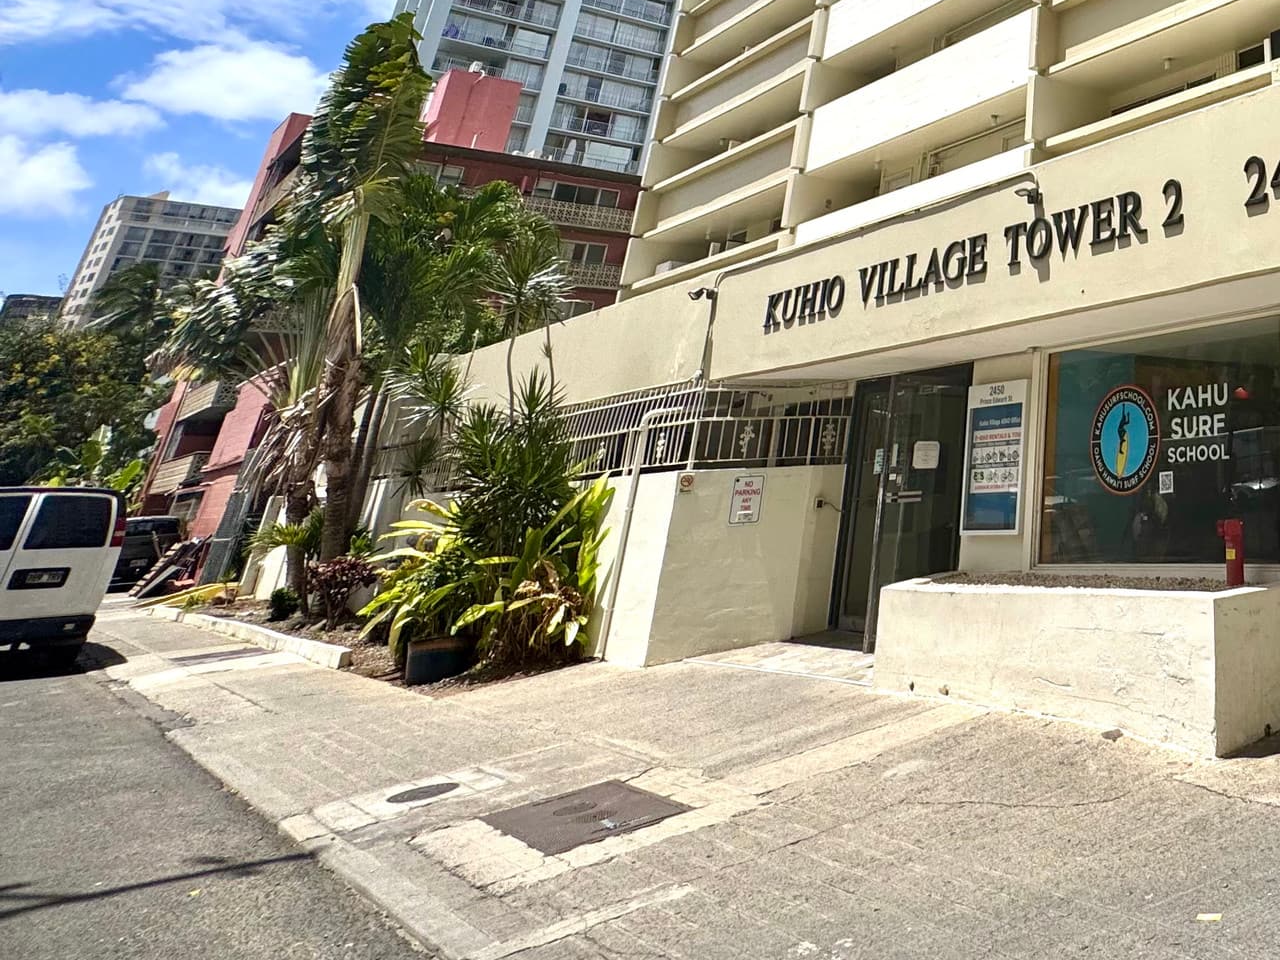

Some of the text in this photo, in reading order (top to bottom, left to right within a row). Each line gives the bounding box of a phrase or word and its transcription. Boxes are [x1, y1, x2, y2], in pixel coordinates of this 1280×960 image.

[763, 275, 845, 331] KUHIO
[858, 233, 988, 307] VILLAGE
[1004, 191, 1148, 268] TOWER
[1162, 179, 1185, 228] 2
[989, 384, 1005, 396] 2450
[1167, 382, 1229, 411] KAHU
[1094, 391, 1156, 436] KAHUSURFSCHOOL.COM
[1171, 413, 1226, 439] SURF
[1167, 443, 1230, 463] SCHOOL
[1124, 476, 1139, 489] SURF
[1140, 444, 1156, 479] SCHOOL
[735, 488, 761, 497] PARKING
[744, 480, 754, 488] NO
